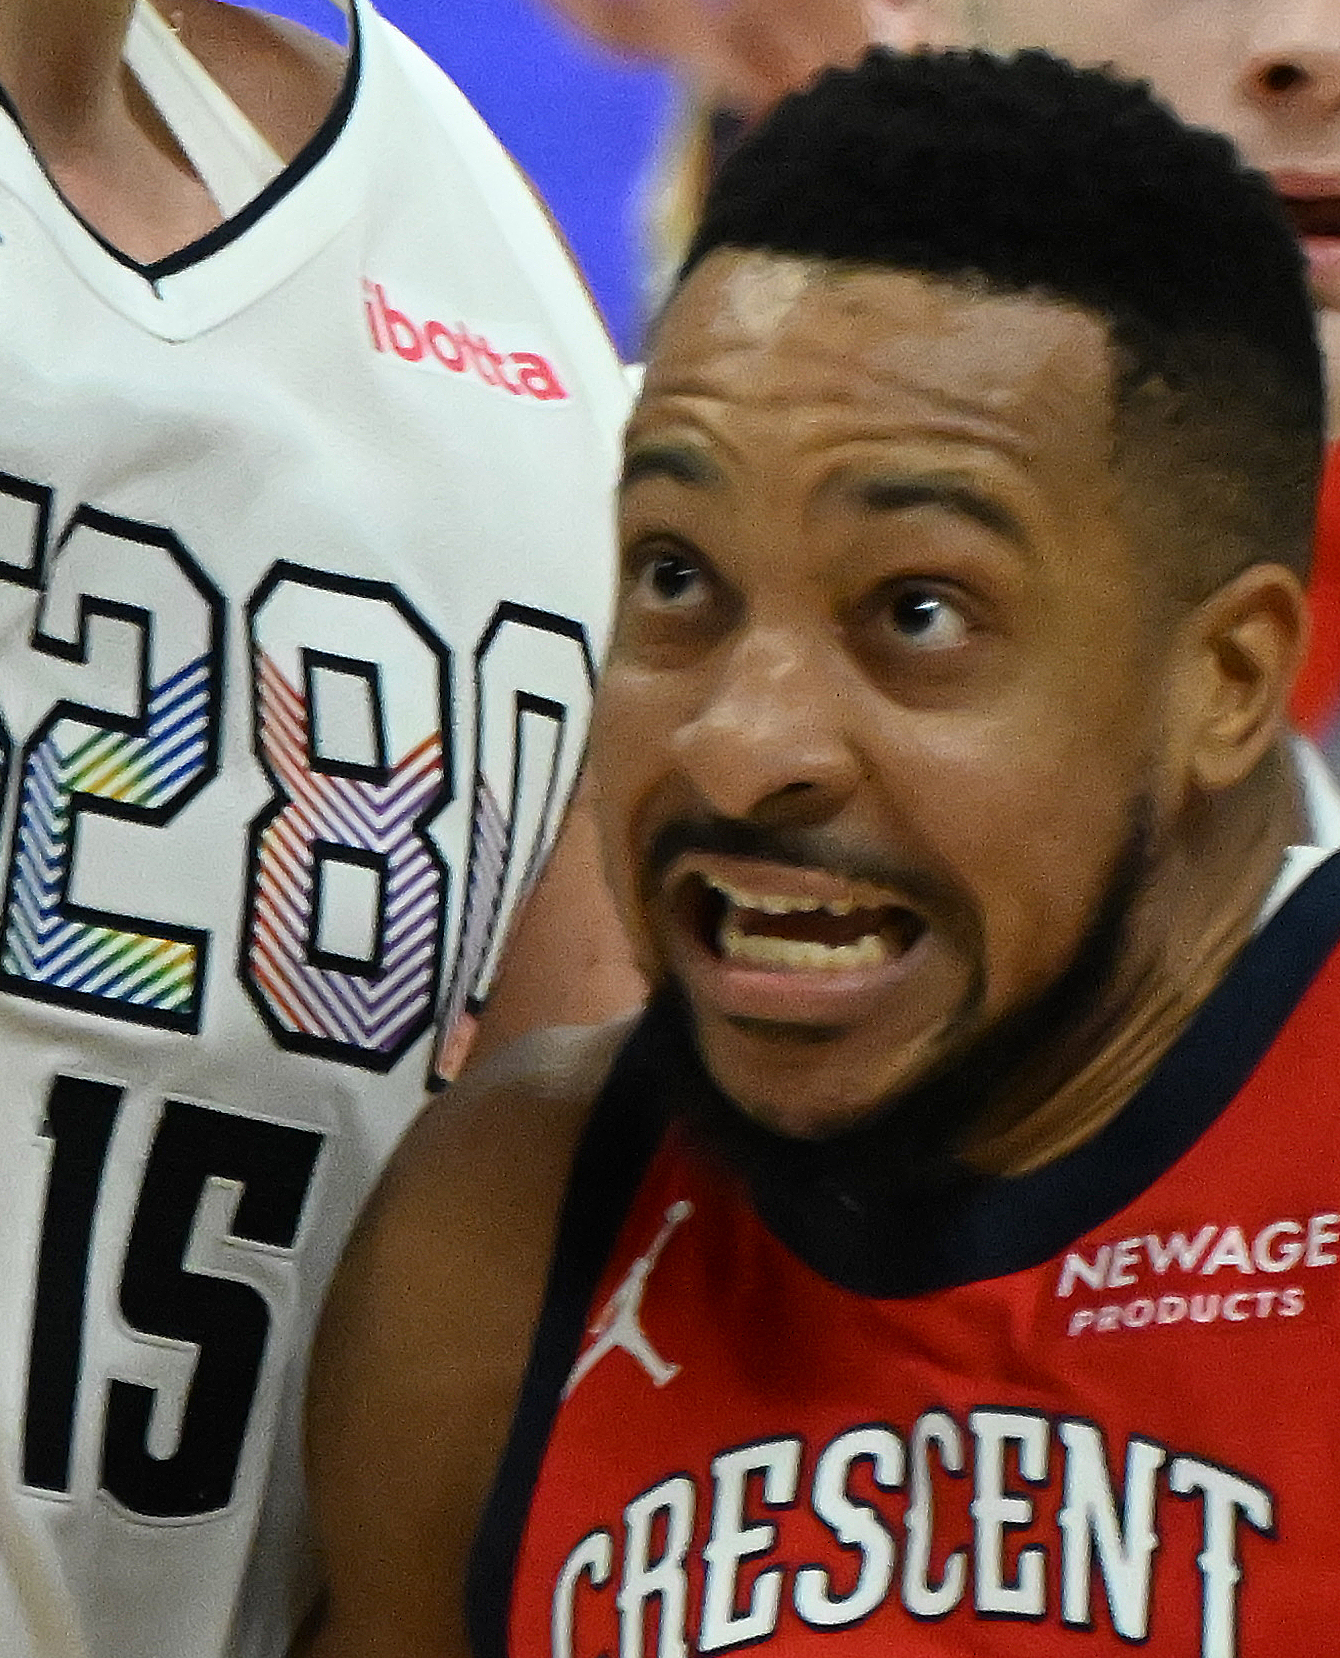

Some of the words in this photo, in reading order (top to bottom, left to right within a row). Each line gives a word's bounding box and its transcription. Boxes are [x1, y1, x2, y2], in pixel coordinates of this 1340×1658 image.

[360, 276, 567, 401] ibotta
[22, 1073, 326, 1518] 15
[1066, 1288, 1305, 1336] PRODUCTS
